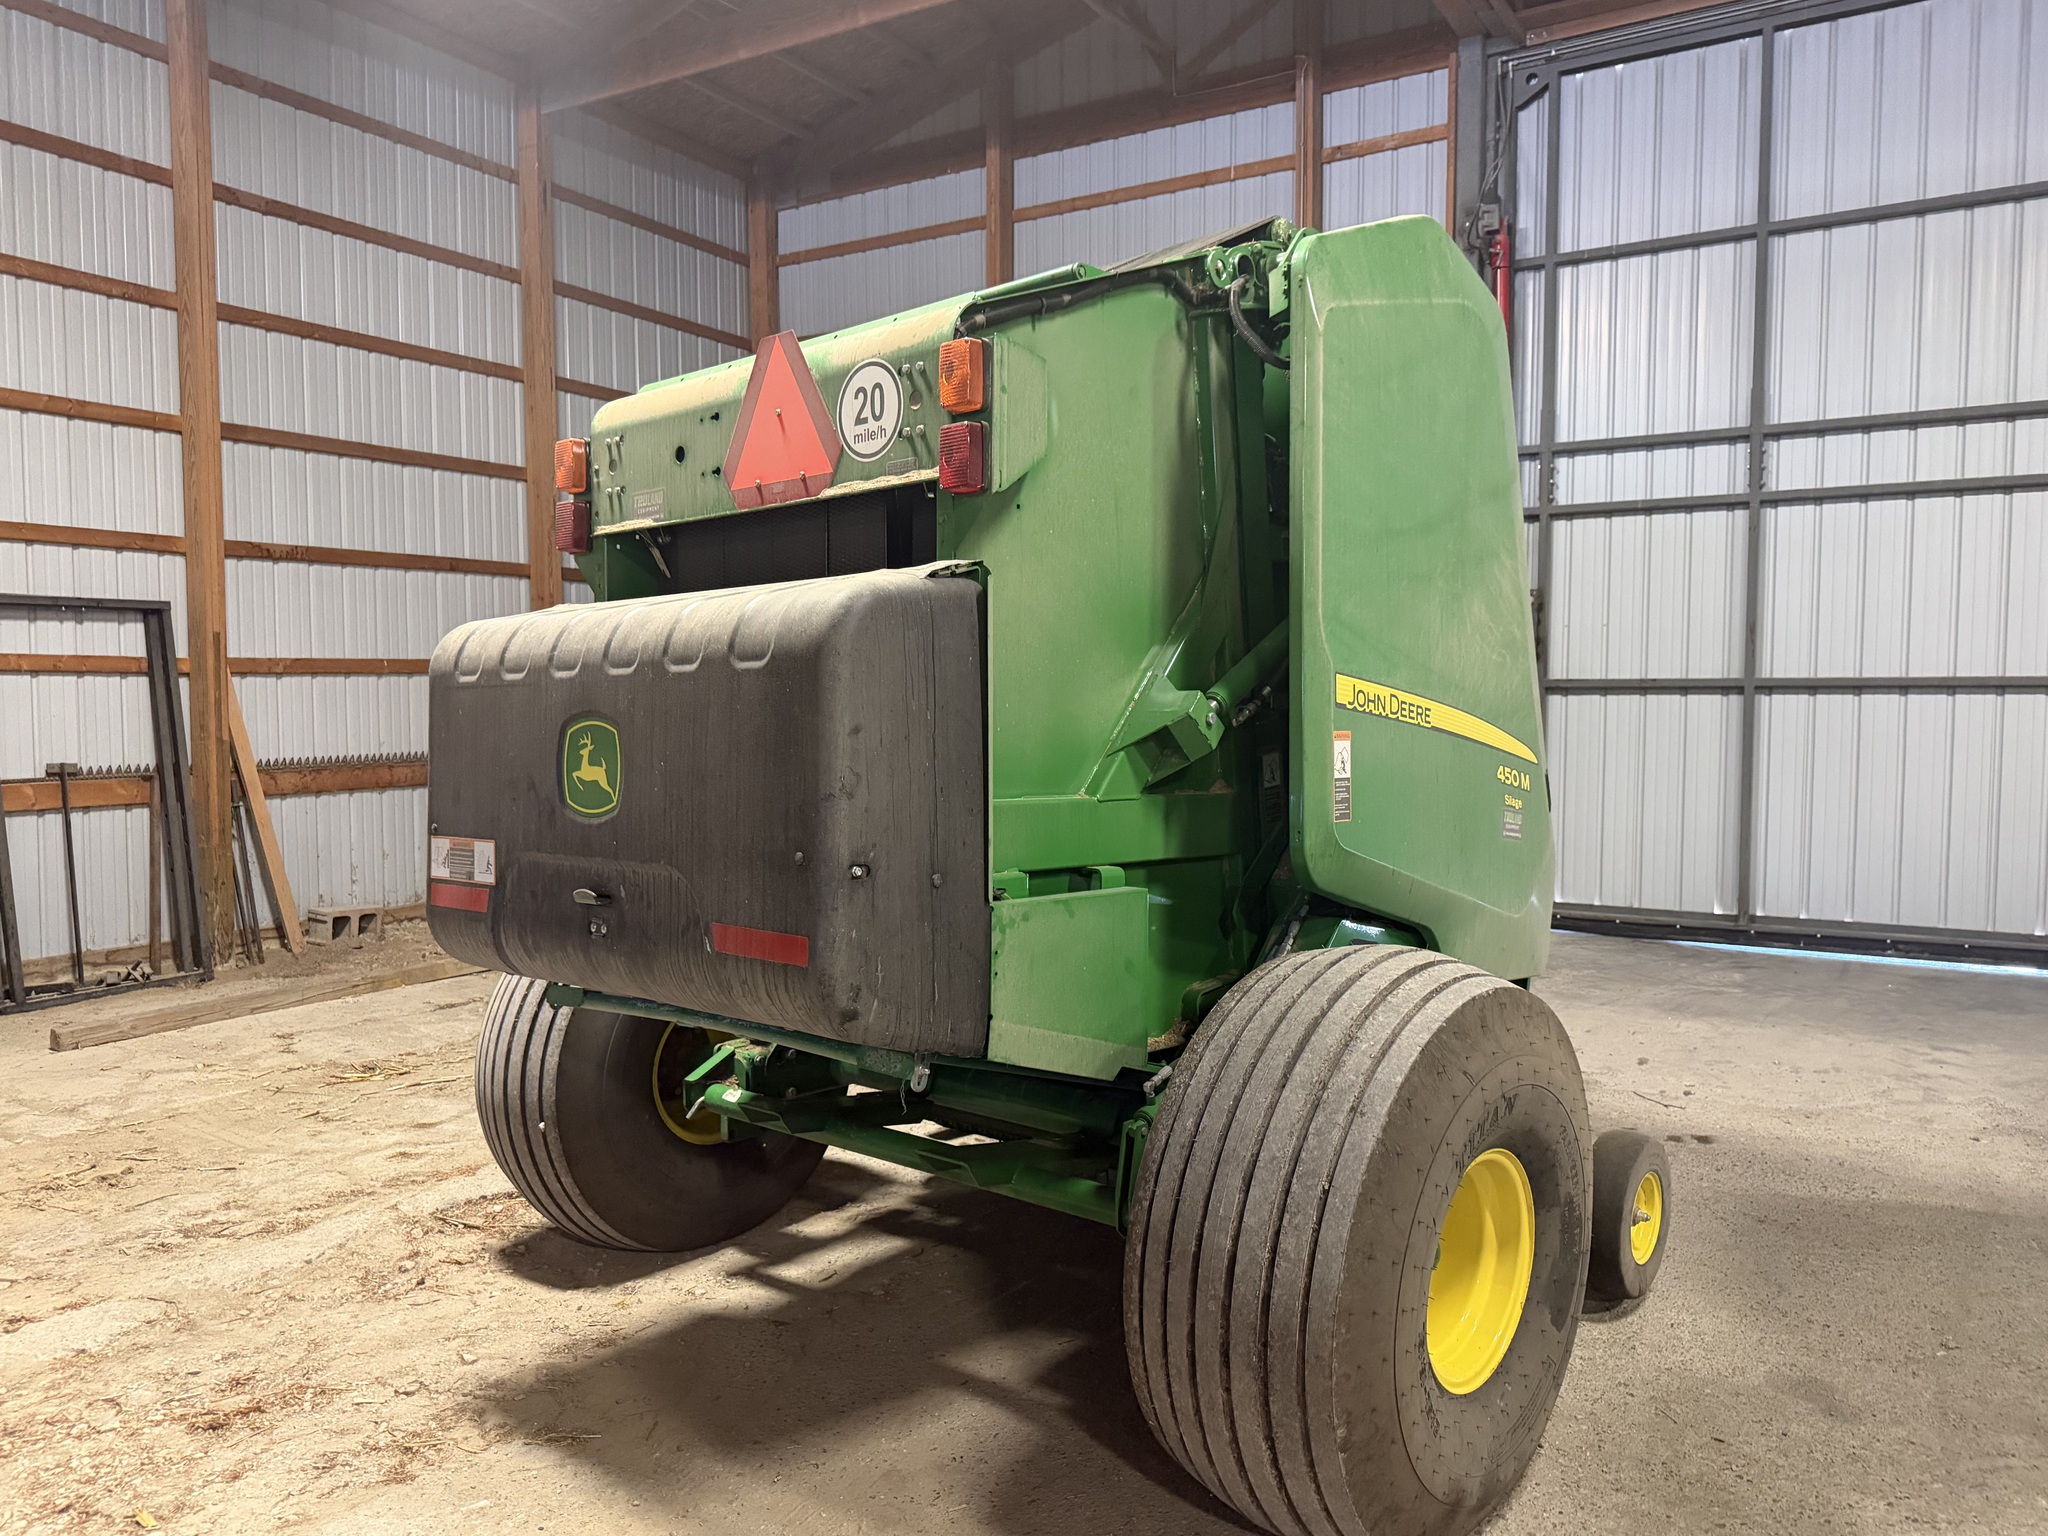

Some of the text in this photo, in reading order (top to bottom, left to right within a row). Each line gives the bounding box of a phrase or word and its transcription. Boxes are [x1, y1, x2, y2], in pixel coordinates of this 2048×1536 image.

[854, 382, 885, 427] 20
[853, 425, 887, 445] mile/h
[1347, 683, 1432, 725] JOHN DEERE
[1496, 764, 1531, 792] 450 M
[1503, 793, 1523, 810] Silage
[1455, 1092, 1519, 1178] TITAN
